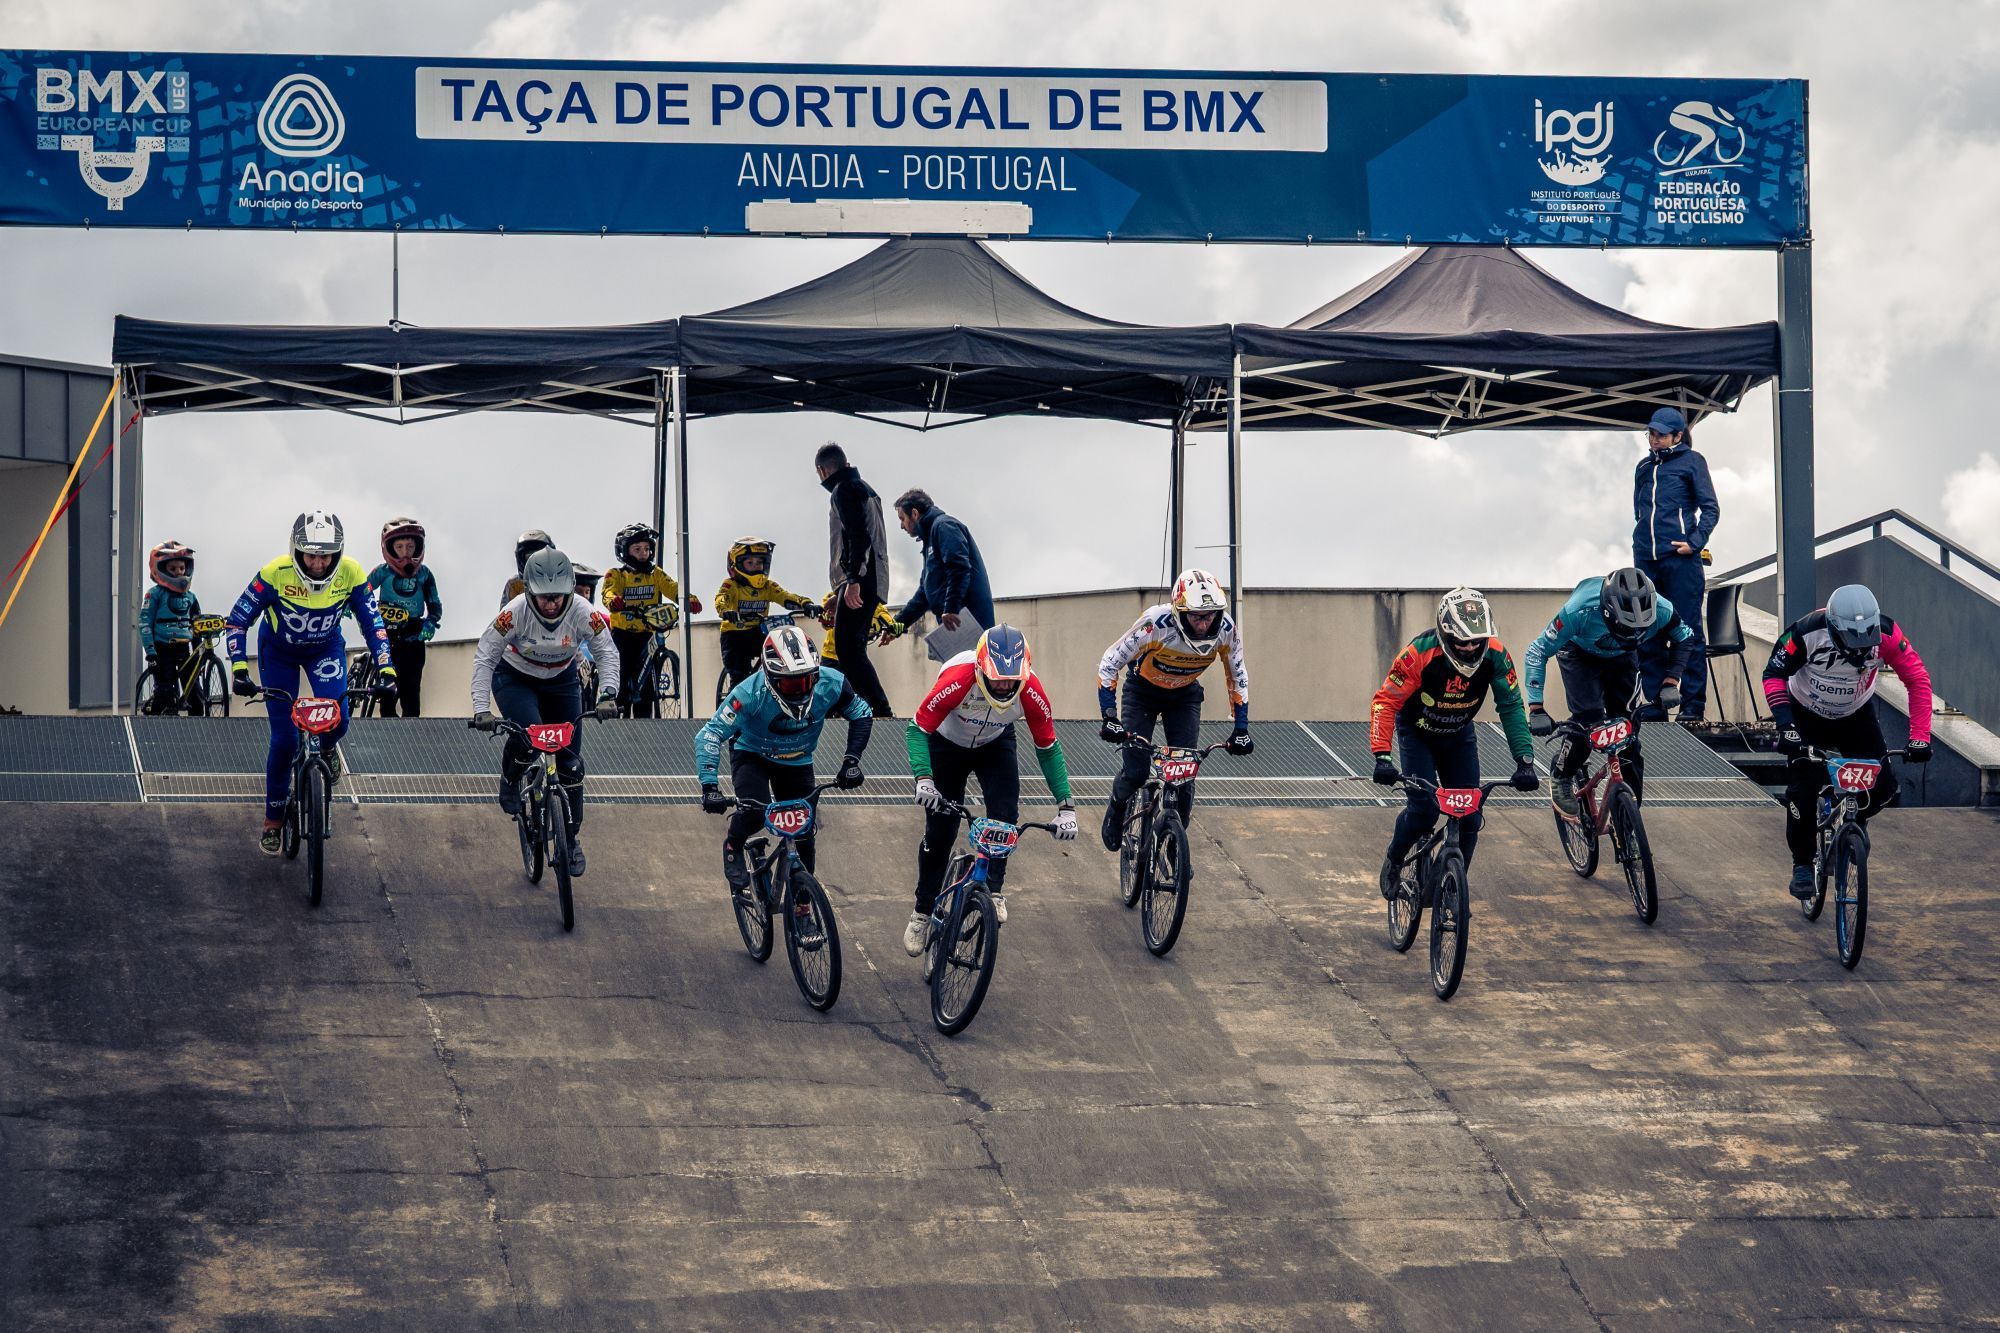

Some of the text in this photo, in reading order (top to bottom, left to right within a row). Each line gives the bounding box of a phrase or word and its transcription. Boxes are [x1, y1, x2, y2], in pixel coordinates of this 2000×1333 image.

[37, 68, 167, 113] BMX
[172, 76, 186, 110] UEC
[441, 79, 1266, 133] TAÇA DE PORTUGAL DE BMX
[37, 116, 192, 133] EUROPEAN CUP
[239, 161, 364, 193] Anadia
[738, 152, 864, 189] ANADIA
[903, 154, 1077, 192] PORTUGAL
[1531, 190, 1621, 200] INSTITUTO PORTUGUÊS
[1659, 180, 1741, 198] FEDERAÇÃO
[238, 197, 363, 211] Município do Desporto
[1547, 203, 1606, 211] DO DESPORTO
[1654, 197, 1746, 210] PORTUGUESA
[1545, 215, 1594, 223] JUVENTUDE
[1657, 211, 1744, 224] DE CICLISMO
[380, 606, 405, 620] 796
[926, 681, 962, 712] PORTUGAL
[308, 706, 334, 723] 424
[537, 729, 563, 743] 421
[1597, 722, 1628, 746] 473
[1165, 763, 1196, 776] 404
[1841, 767, 1874, 786] 474
[1446, 794, 1473, 808] 402
[773, 809, 807, 829] 403
[984, 829, 1010, 844] 401
